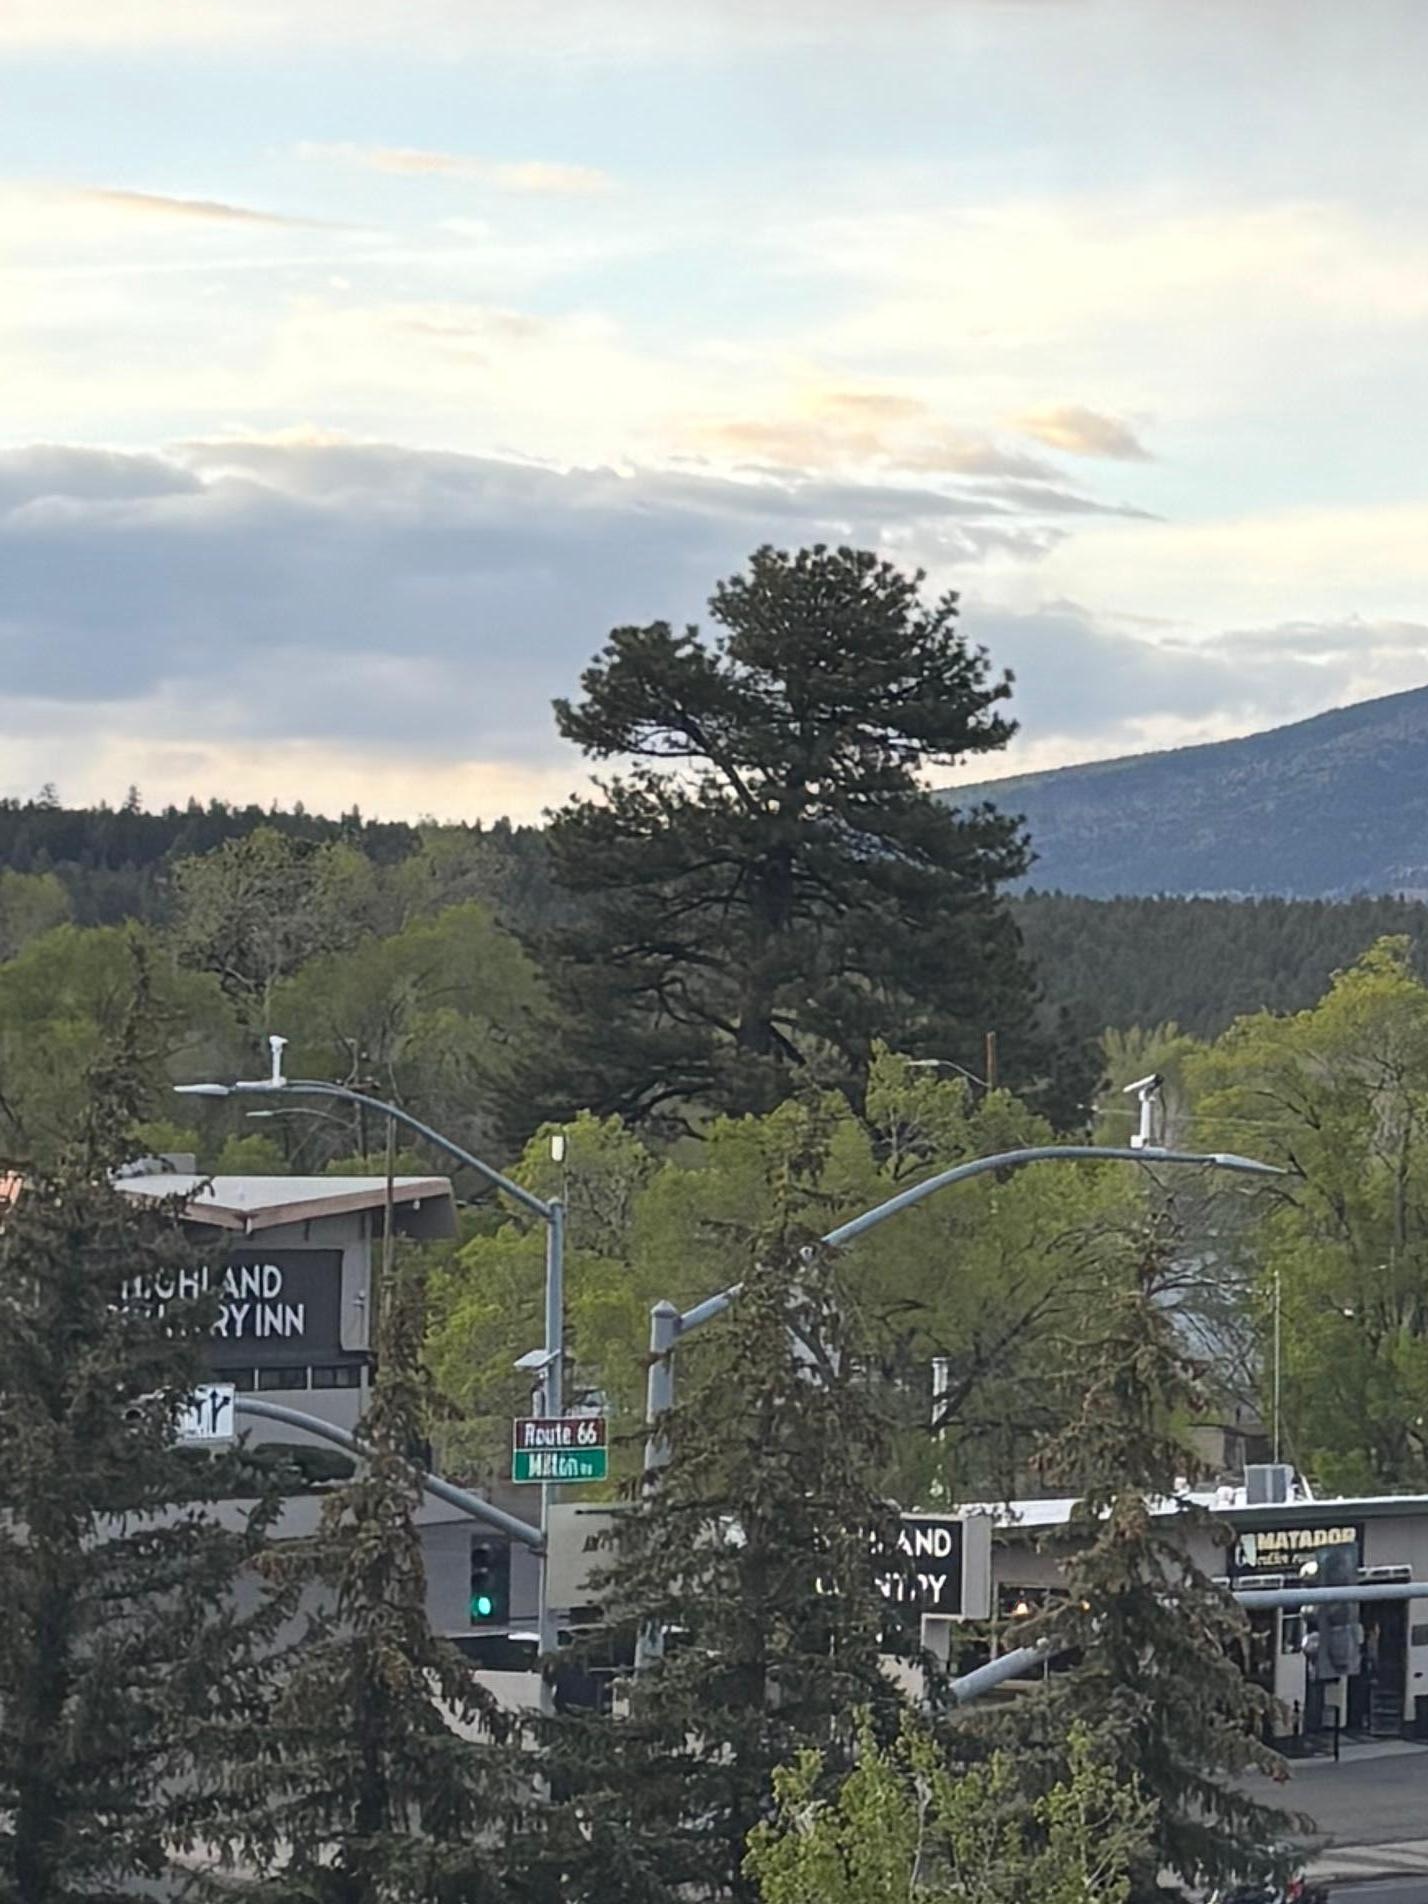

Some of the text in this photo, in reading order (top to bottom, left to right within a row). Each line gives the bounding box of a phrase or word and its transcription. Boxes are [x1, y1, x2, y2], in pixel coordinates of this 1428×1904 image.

[255, 1302, 304, 1337] INN
[524, 1421, 597, 1446] Route 66
[1256, 1527, 1357, 1551] MATADOR
